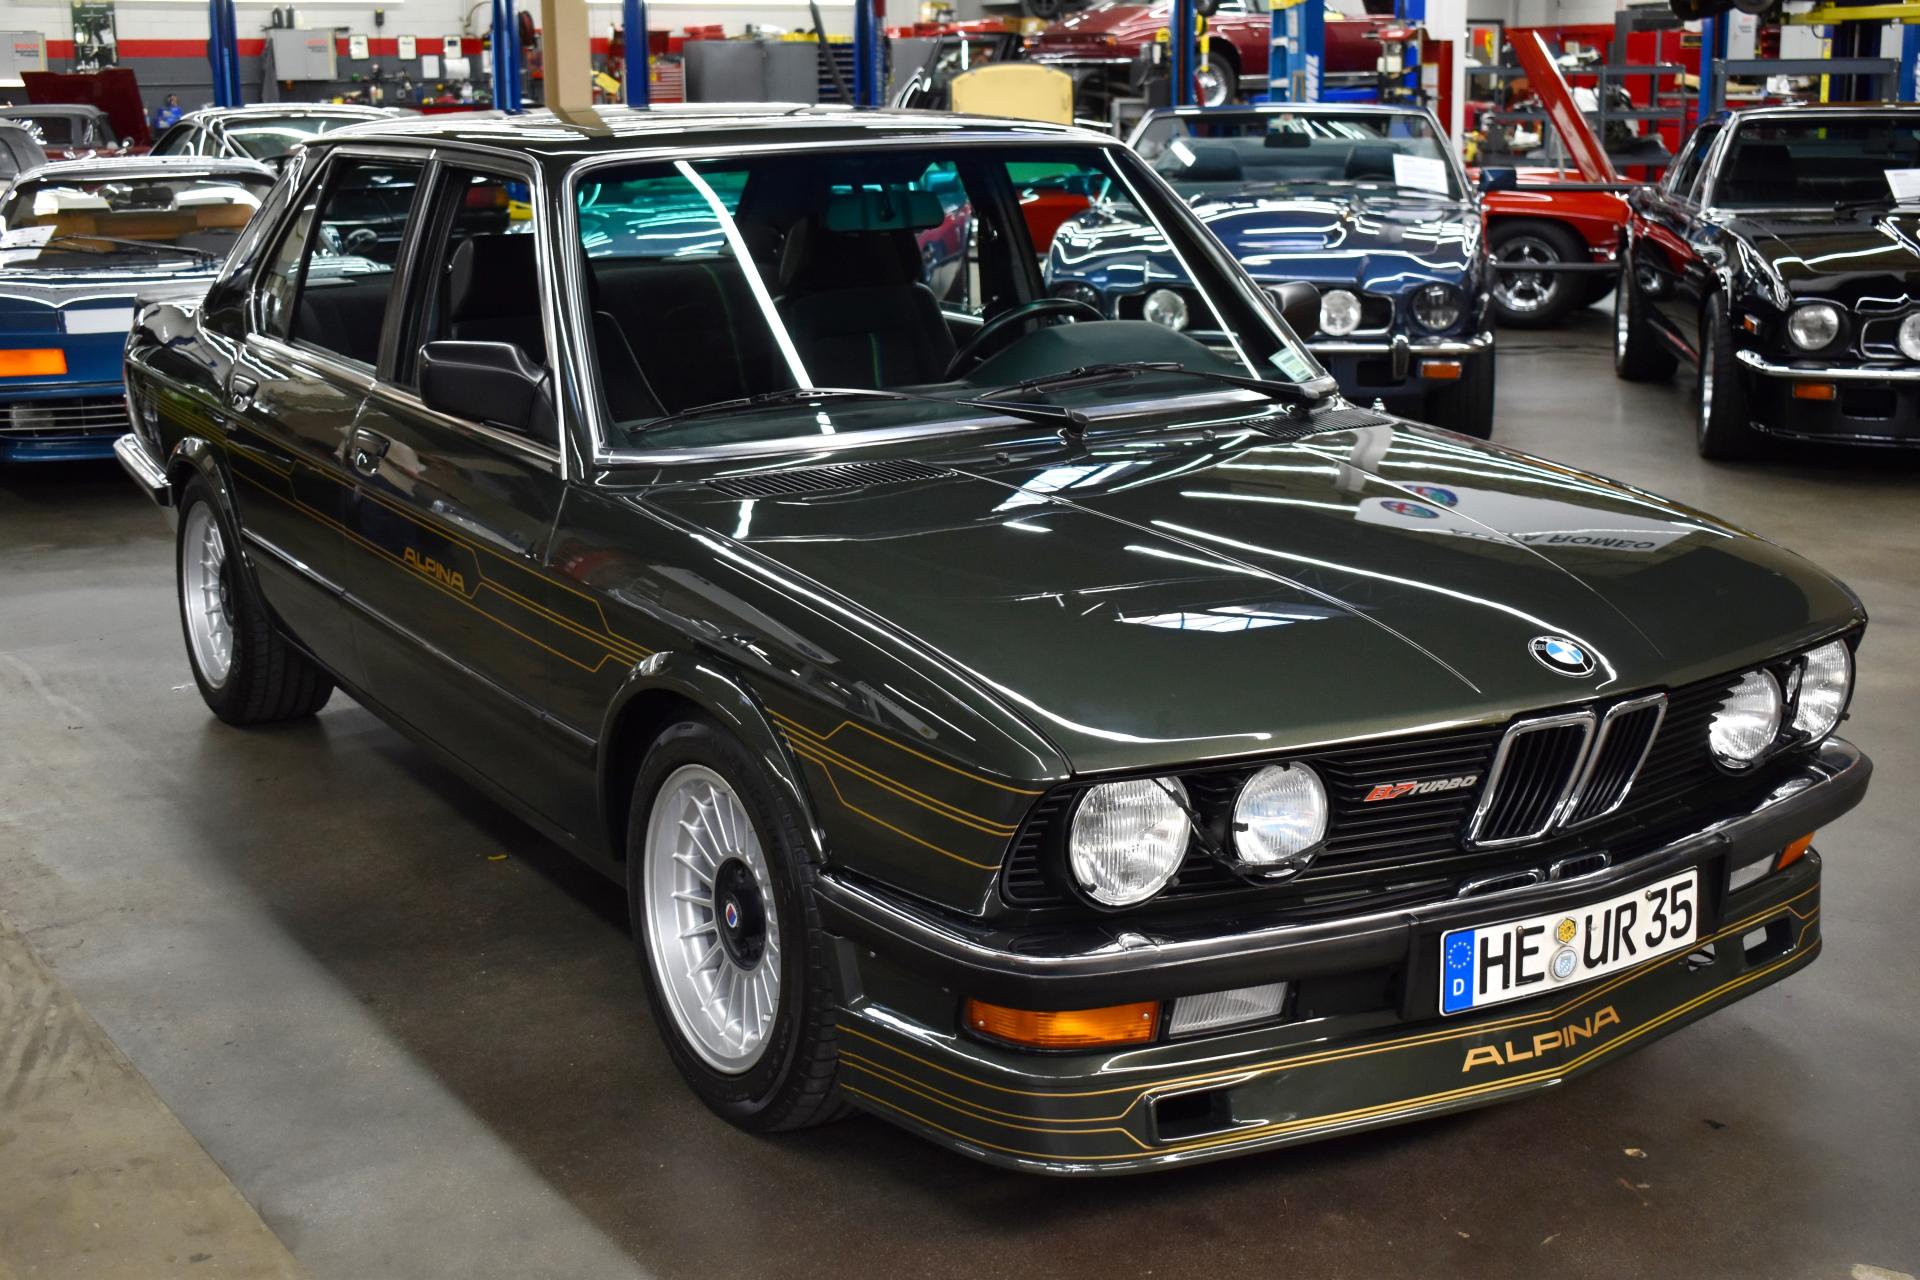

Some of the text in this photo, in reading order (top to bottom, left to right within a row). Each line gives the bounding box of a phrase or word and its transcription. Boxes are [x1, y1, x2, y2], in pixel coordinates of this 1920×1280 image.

[403, 546, 465, 592] ALPINA
[1479, 880, 1693, 995] HE UR 35
[1452, 979, 1465, 996] D
[1462, 1005, 1621, 1073] ALPINA
